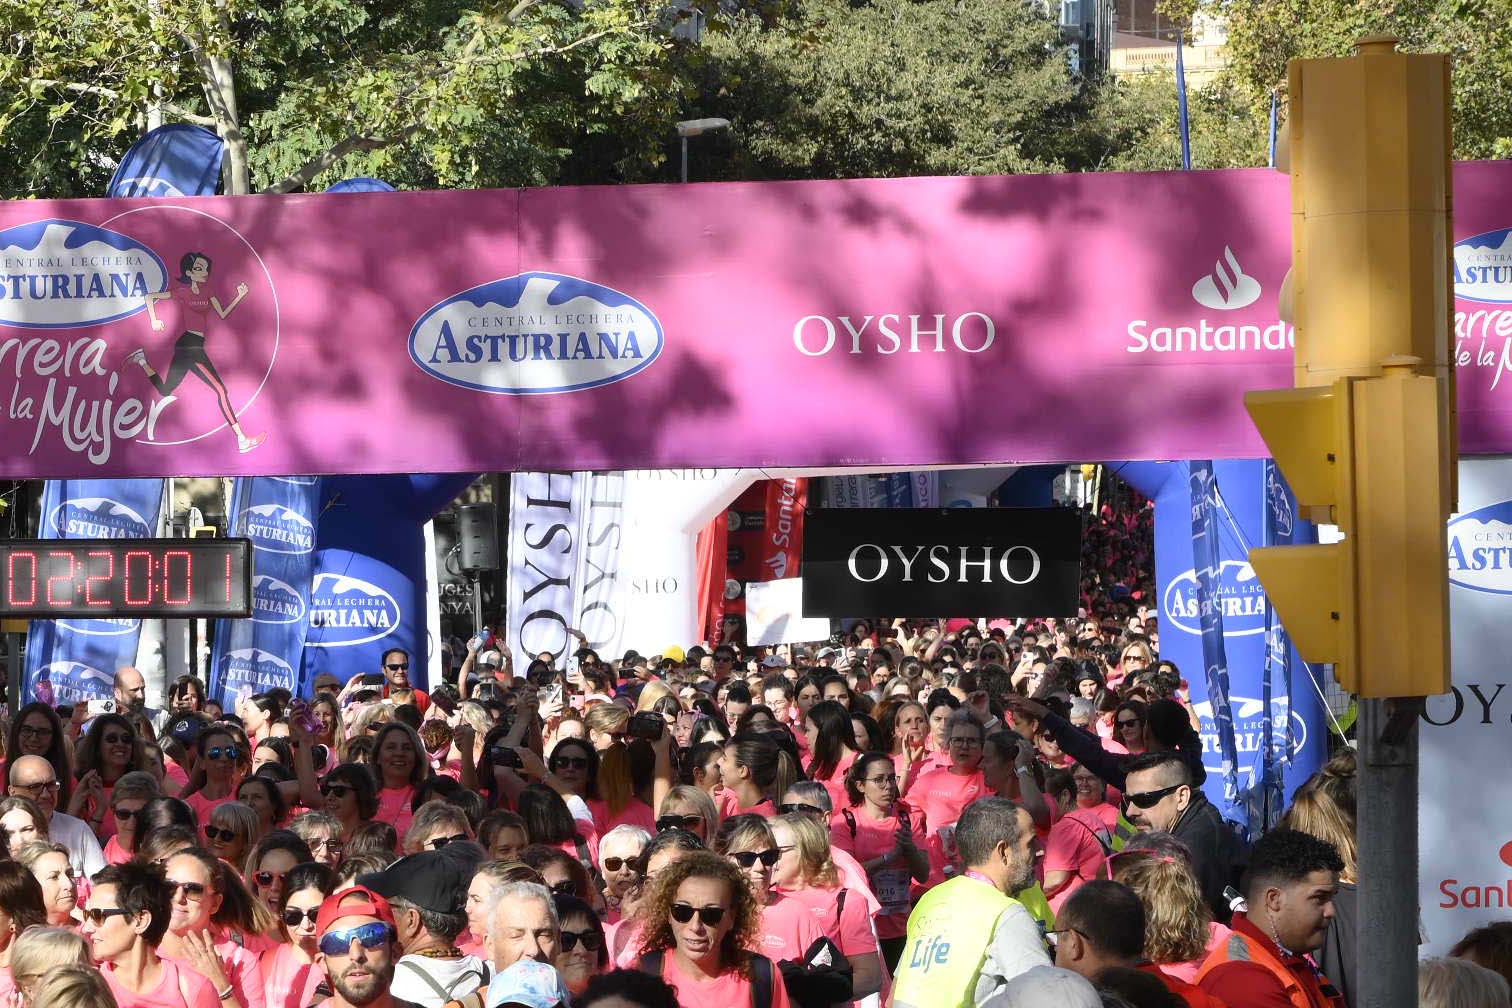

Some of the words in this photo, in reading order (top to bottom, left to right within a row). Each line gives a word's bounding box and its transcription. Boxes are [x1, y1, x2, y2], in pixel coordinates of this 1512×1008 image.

[70, 255, 144, 267] LECHERA
[467, 314, 548, 328] CENTRAL
[553, 312, 637, 326] LECHERA
[792, 311, 996, 357] OYSHO
[428, 319, 644, 365] ASTURIANA
[1477, 338, 1495, 367] la
[9, 378, 34, 420] la
[28, 371, 178, 465] Mujer
[9, 551, 231, 605] 02:20:01
[847, 544, 1041, 584] OYSHO
[337, 598, 386, 607] LECHERA
[1420, 683, 1512, 727] OY
[910, 934, 950, 974] Life
